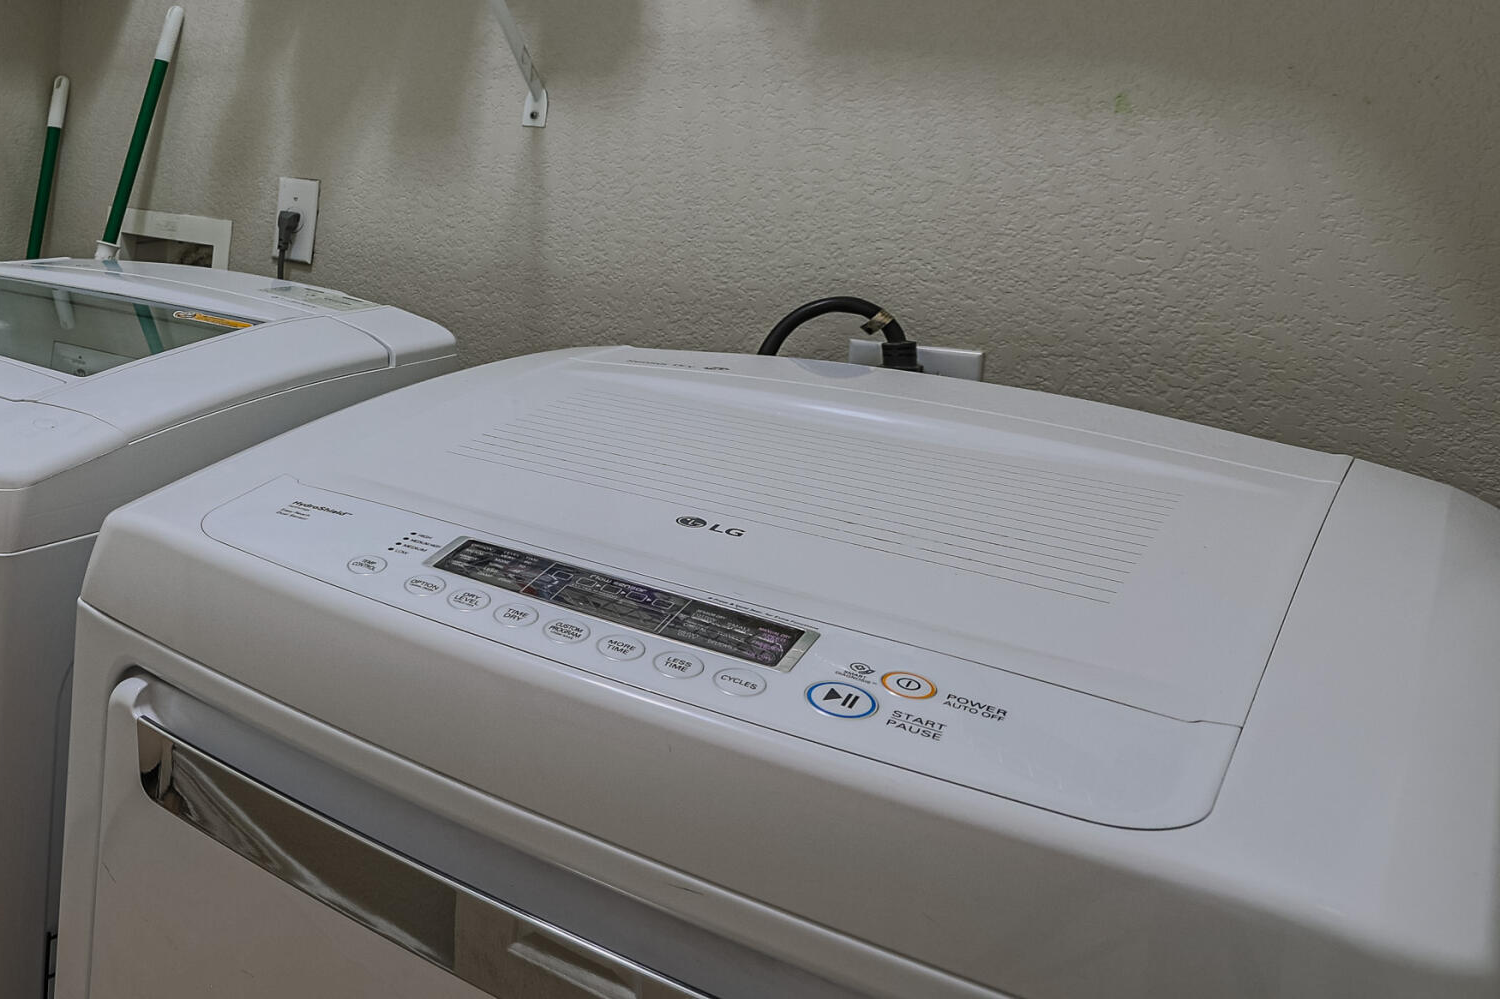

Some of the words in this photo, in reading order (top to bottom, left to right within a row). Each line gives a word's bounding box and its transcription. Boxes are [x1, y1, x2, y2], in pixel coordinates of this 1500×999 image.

[709, 524, 746, 537] LG
[410, 579, 439, 590] OPTION
[454, 594, 480, 606] LEVEL
[463, 592, 482, 600] DRY
[503, 613, 523, 622] DRY
[508, 608, 530, 618] TIME
[548, 625, 582, 639] PROGRAM
[556, 622, 584, 633] CUSTOM
[607, 644, 630, 656] TIME
[608, 639, 636, 651] MORE
[664, 661, 688, 673] TIME
[666, 656, 693, 668] LESS
[720, 674, 758, 690] CYCLES
[943, 700, 978, 715] AUTO
[981, 711, 1006, 722] OFF
[946, 693, 1008, 717] POWER
[891, 710, 947, 731] START
[885, 719, 943, 741] PAUSE
